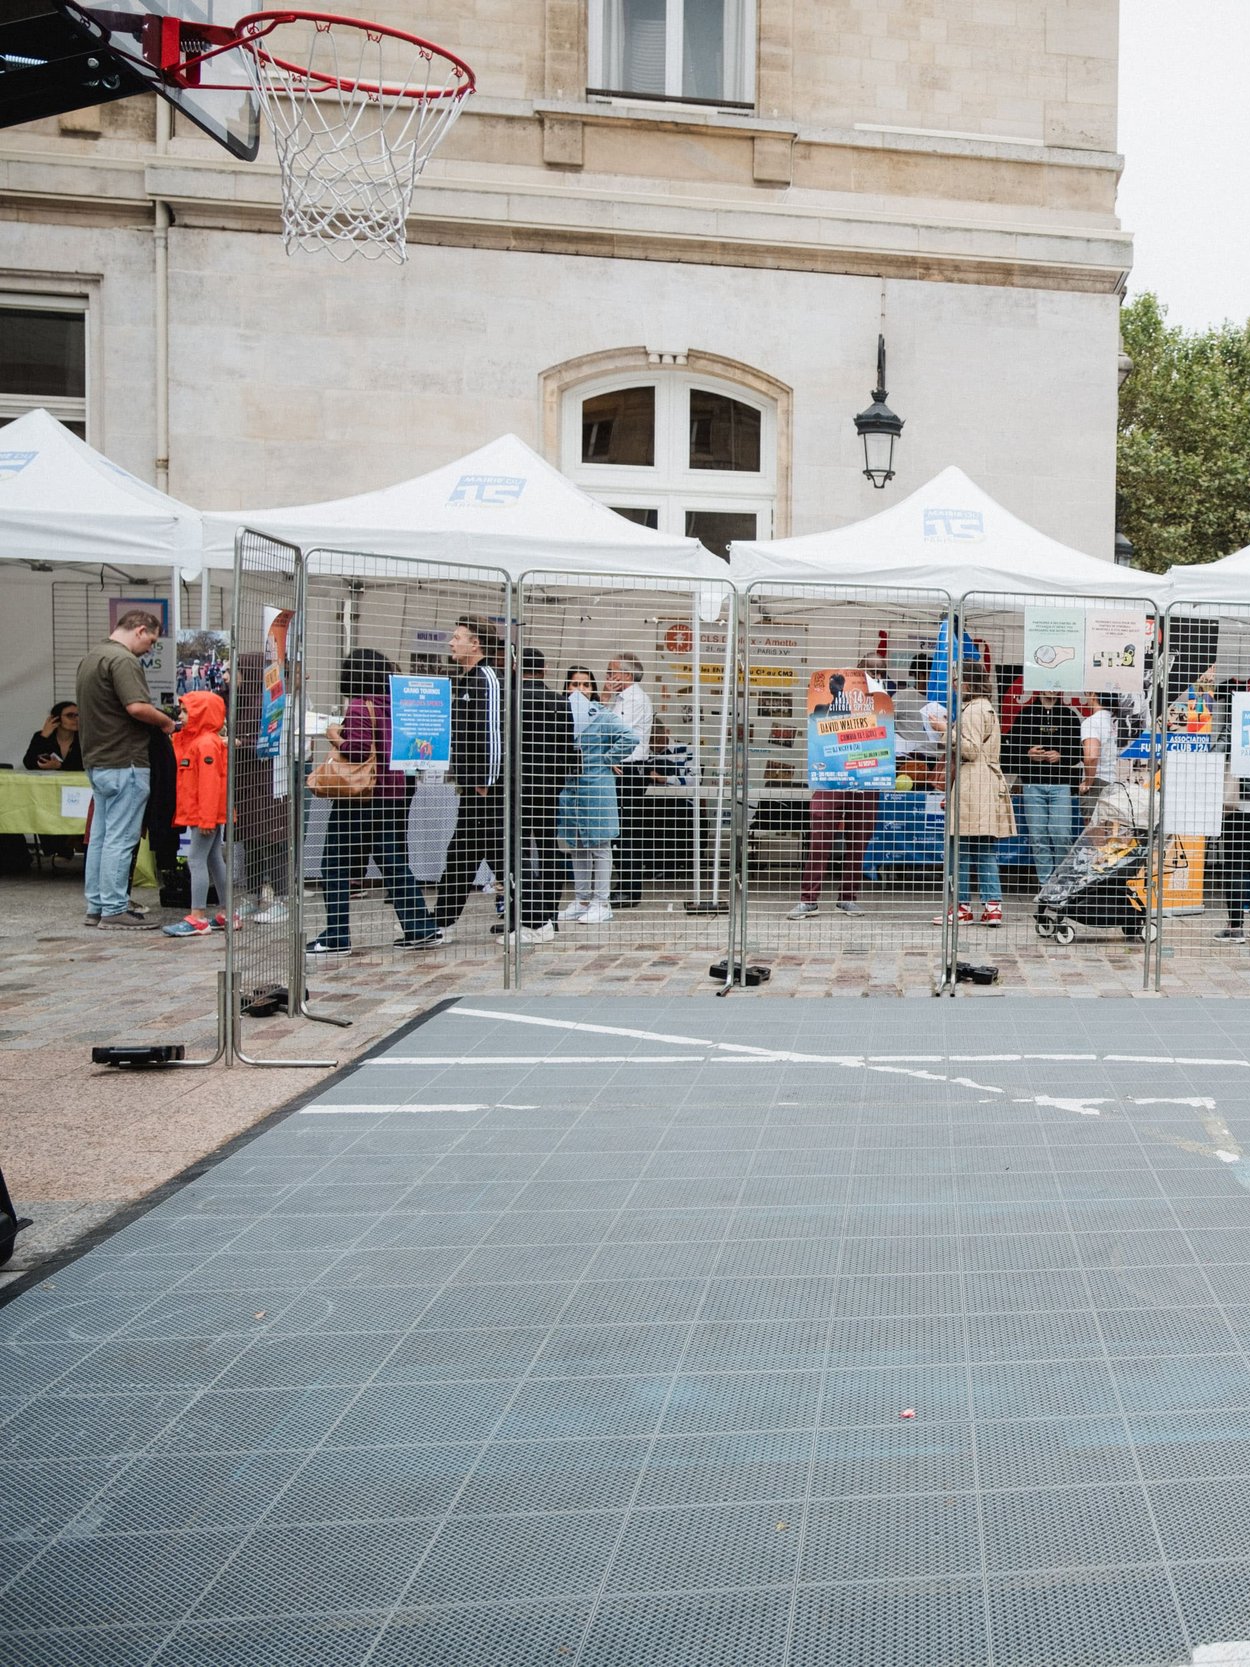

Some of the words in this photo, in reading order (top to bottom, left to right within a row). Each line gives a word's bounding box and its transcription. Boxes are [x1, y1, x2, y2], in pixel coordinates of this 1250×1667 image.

[820, 720, 839, 733] DAVID
[839, 717, 868, 731] WALTERS
[1170, 735, 1209, 743] ASSOCIATION
[1170, 744, 1191, 752] CLUB
